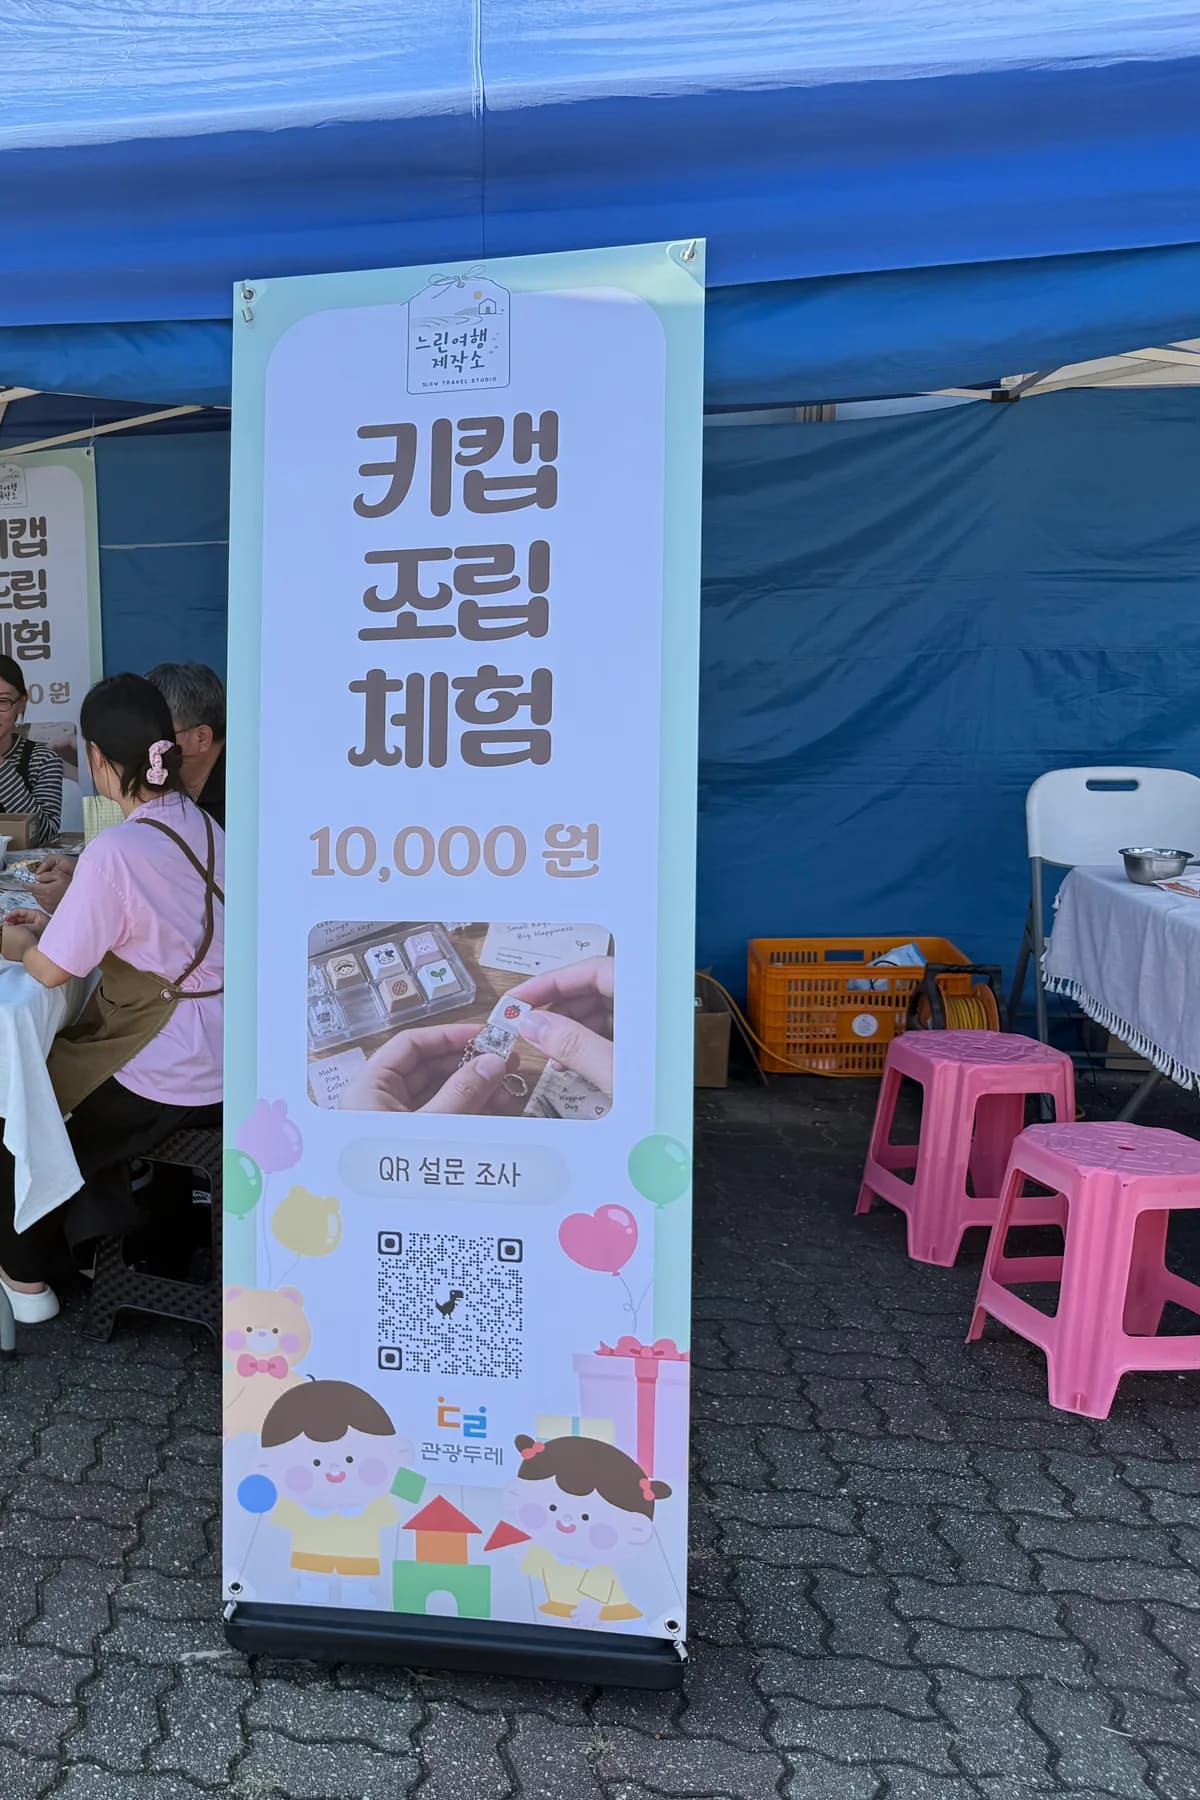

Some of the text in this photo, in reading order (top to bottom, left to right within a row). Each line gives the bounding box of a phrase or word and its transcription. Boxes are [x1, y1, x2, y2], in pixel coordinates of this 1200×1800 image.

[415, 328, 488, 354] 느린여행
[431, 350, 485, 373] 제작소
[471, 376, 497, 384] STUDIO
[353, 410, 560, 519] 키캡
[357, 540, 551, 641] 조립
[49, 681, 71, 705] 원
[348, 664, 554, 769] 체험
[309, 823, 600, 883] 10,000 원
[379, 1156, 522, 1188] QR 설문 조사
[421, 1442, 503, 1466] 관광두레
